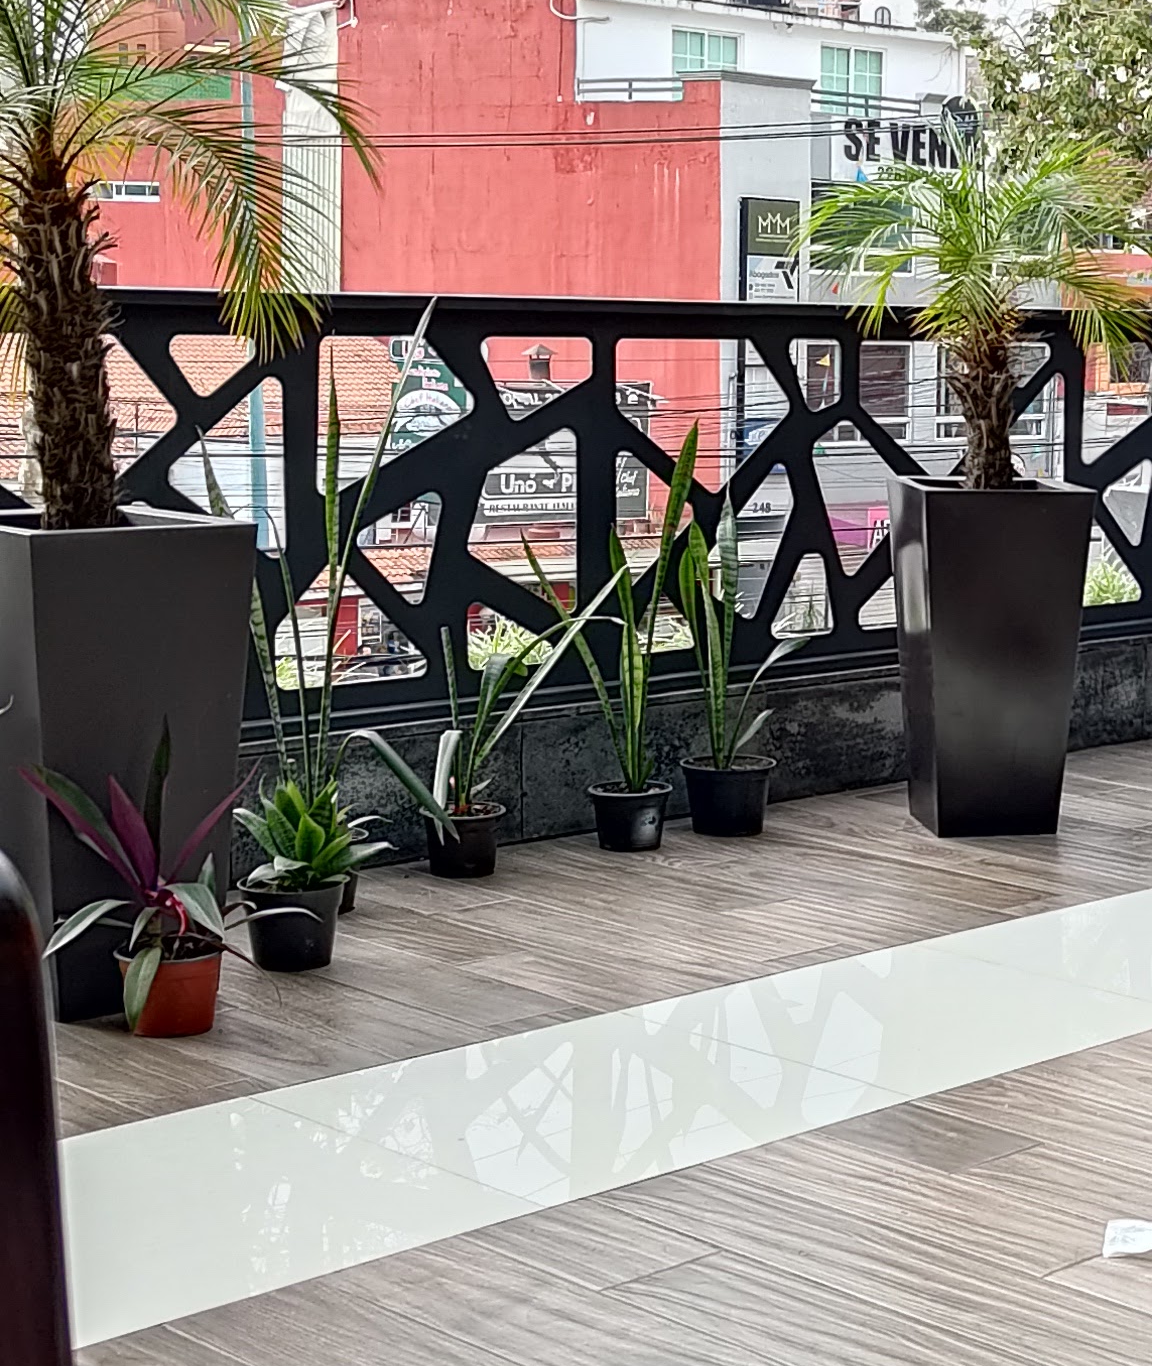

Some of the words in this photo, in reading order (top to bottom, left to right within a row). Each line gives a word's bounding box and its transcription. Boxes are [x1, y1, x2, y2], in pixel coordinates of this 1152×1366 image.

[844, 118, 880, 162] SE
[889, 122, 962, 170] VEN
[752, 503, 771, 513] 248
